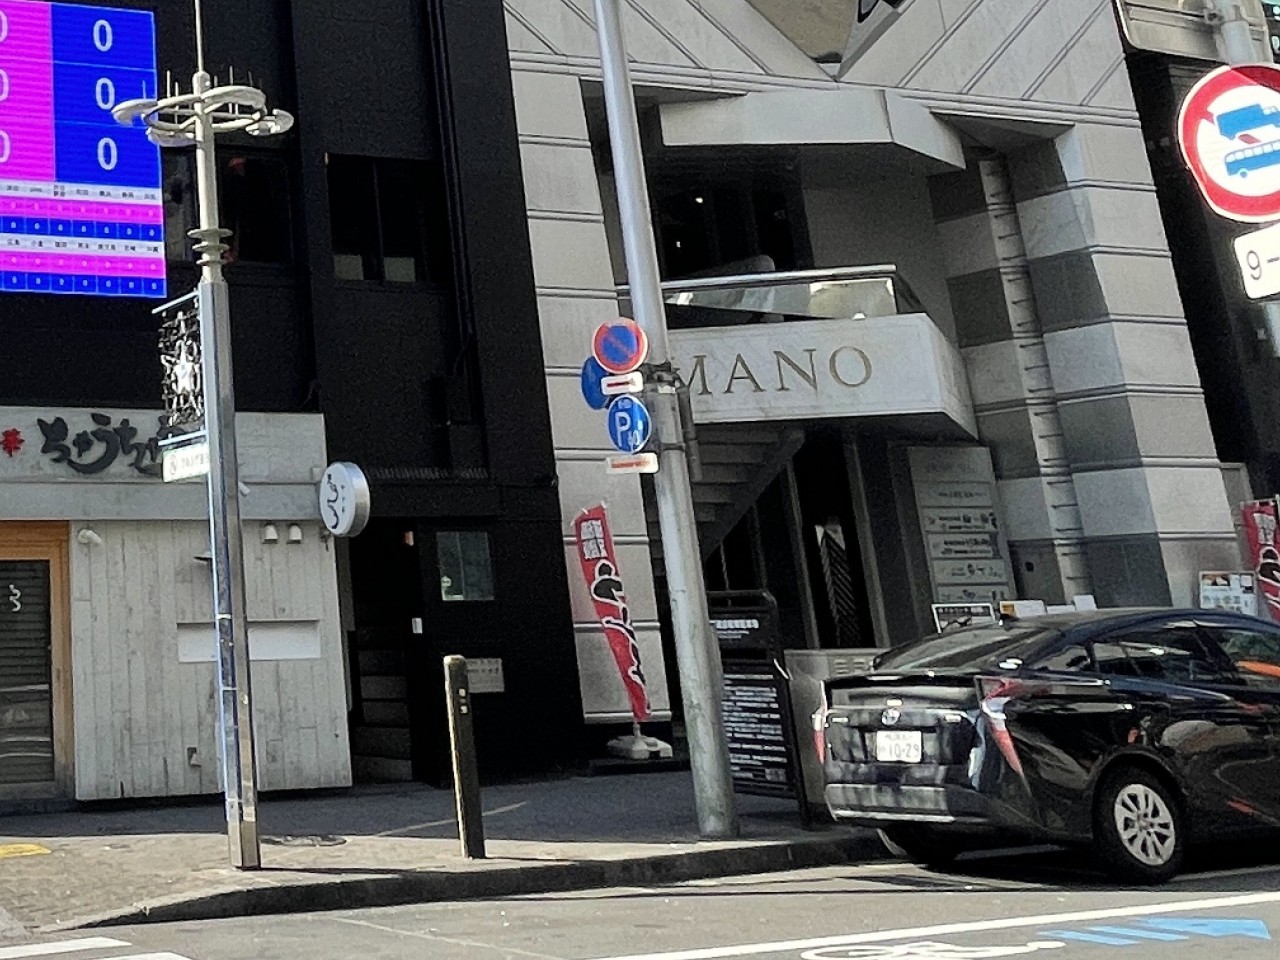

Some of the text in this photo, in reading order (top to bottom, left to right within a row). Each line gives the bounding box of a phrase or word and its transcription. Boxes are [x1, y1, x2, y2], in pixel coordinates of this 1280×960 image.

[93, 19, 113, 52] 0
[95, 78, 115, 110] 0
[97, 137, 117, 170] 0
